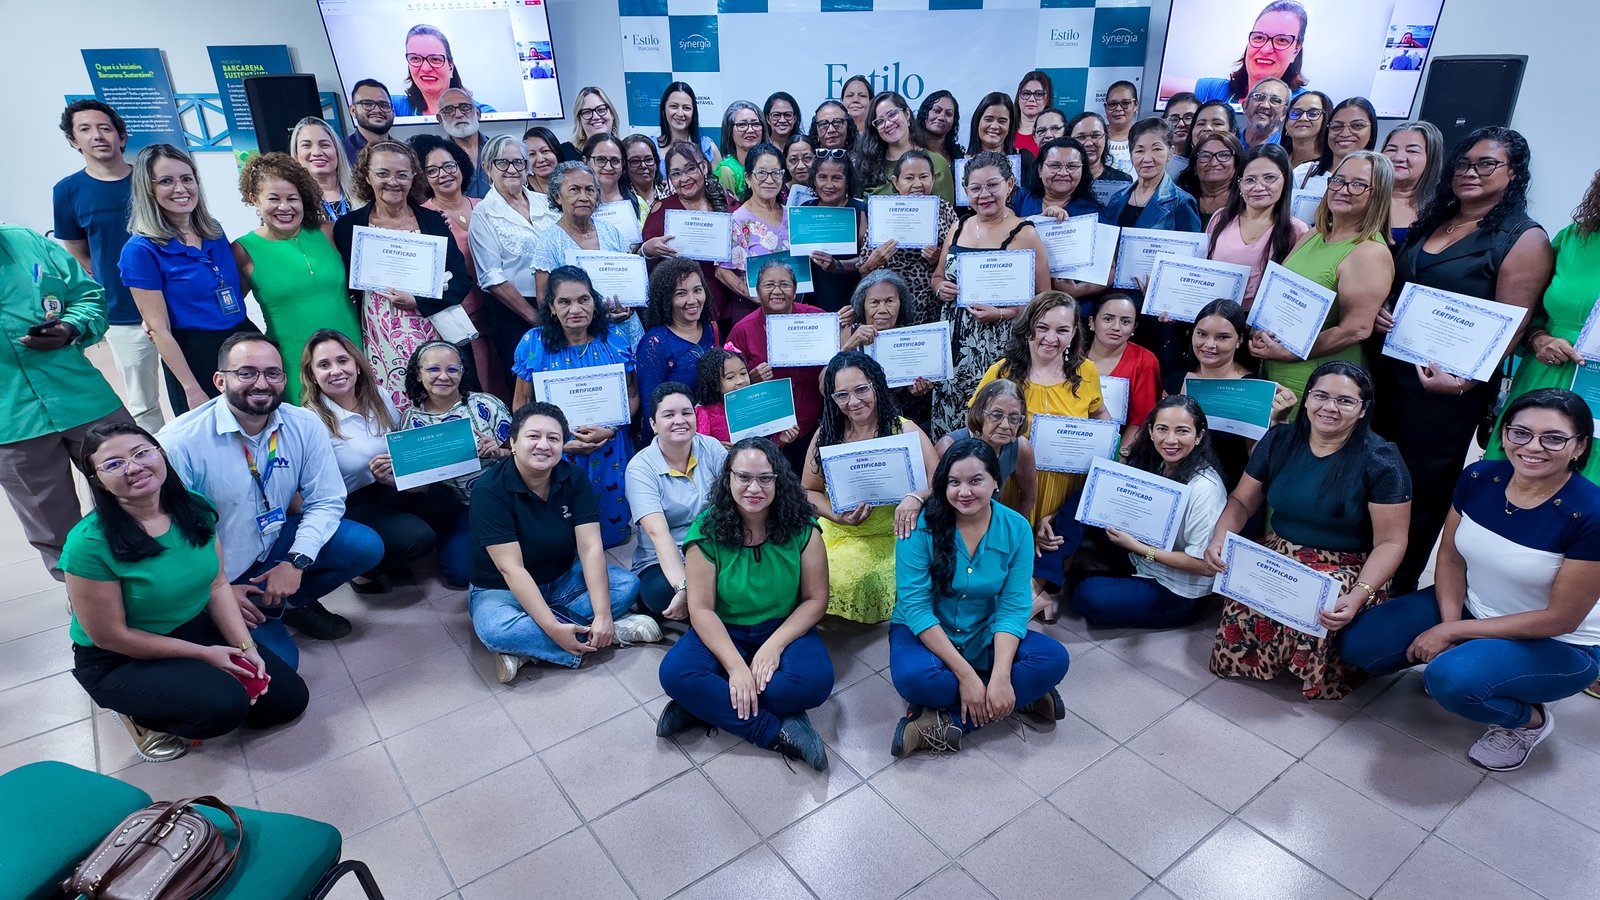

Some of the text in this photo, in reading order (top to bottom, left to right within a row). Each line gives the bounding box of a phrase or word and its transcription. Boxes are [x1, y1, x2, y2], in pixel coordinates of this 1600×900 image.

[632, 34, 659, 46] Estilo
[1050, 28, 1080, 40] Estilo
[1102, 33, 1138, 44] synergia
[678, 38, 711, 50] synergia
[824, 62, 924, 100] Etilo
[1045, 229, 1077, 237] CERTIFICADO
[382, 248, 417, 258] CERTIFICADO
[1180, 277, 1216, 287] CERTIFICADO
[1282, 292, 1307, 309] CERTIFICADO
[1432, 309, 1475, 328] CERTIFICADO
[569, 386, 602, 394] CERTIFICADO
[1056, 429, 1094, 437] CERTIFICADO
[850, 462, 886, 470] CERTIFICADO
[1116, 486, 1153, 502] CERTIFICADO
[1256, 561, 1298, 583] CERTIFICADO
